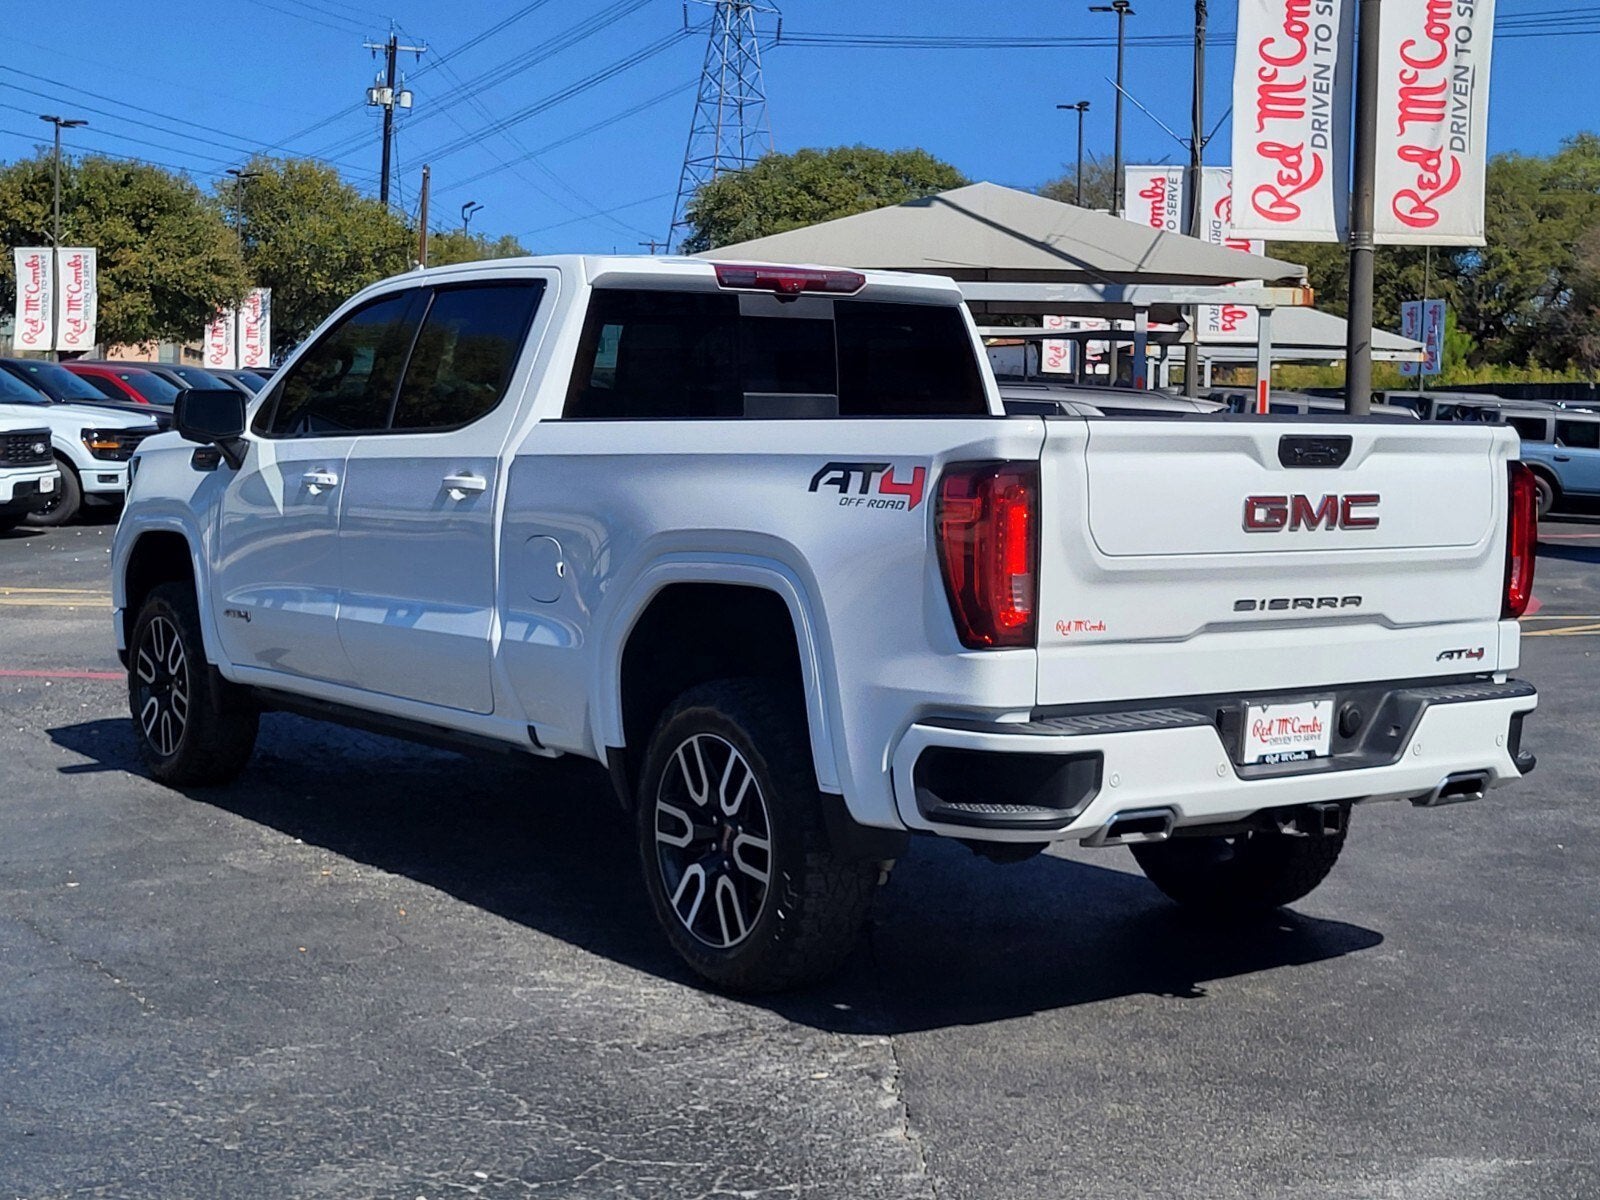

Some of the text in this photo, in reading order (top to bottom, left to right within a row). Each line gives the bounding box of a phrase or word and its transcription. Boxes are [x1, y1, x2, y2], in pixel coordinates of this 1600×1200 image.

[1314, 24, 1332, 55] TO
[1455, 26, 1473, 57] TO
[1252, 0, 1324, 222] Red McCom
[1311, 63, 1332, 150] DRIVEN
[1392, 0, 1461, 228] Red McCom
[1450, 65, 1470, 153] DRIVEN
[1167, 177, 1178, 216] SERVE
[21, 255, 45, 344] Red McCombs
[41, 279, 47, 290] TO
[64, 254, 87, 344] Red McCombs
[84, 279, 90, 290] TO
[210, 343, 228, 365] Red
[245, 344, 263, 365] Red
[808, 462, 926, 512] AT4
[839, 497, 906, 511] OFF ROAD
[1242, 494, 1380, 533] GMC
[1233, 595, 1362, 612] SIERRA
[1056, 619, 1107, 636] Red McCombs
[1436, 647, 1485, 661] AT4
[1253, 716, 1323, 743] Red McCombs
